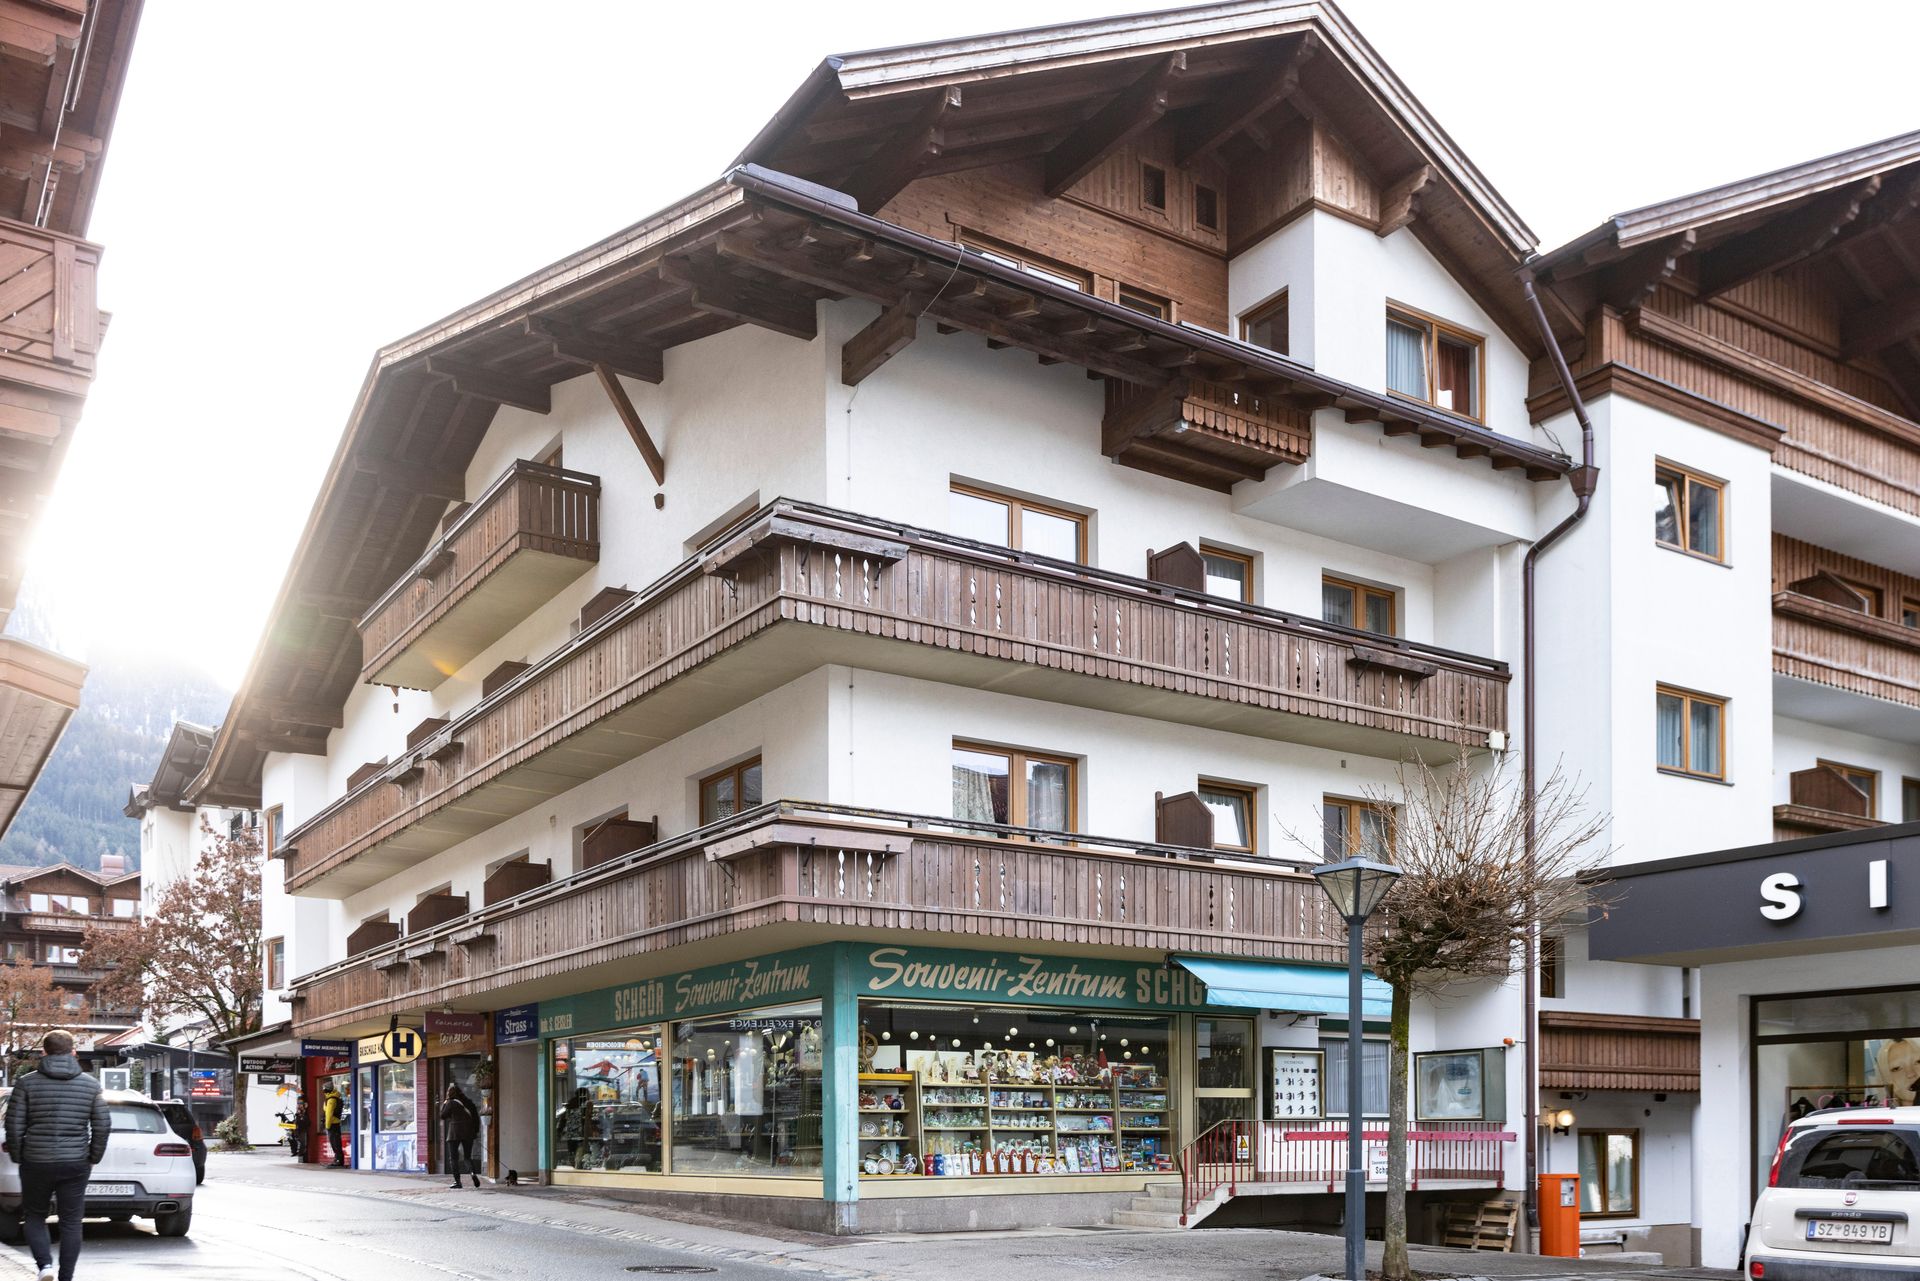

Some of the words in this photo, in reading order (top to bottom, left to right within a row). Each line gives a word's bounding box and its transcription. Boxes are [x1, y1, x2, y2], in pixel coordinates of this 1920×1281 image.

[869, 948, 1127, 998] Souvenir-Zentrum
[1136, 968, 1203, 1006] SCHG
[615, 980, 664, 1022] SCHGÖR
[675, 960, 810, 1013] Souvenir-Zentrum
[505, 1020, 527, 1035] Strass
[392, 1033, 414, 1057] H
[1818, 1223, 1834, 1236] SZ
[1843, 1224, 1867, 1238] 849
[1871, 1225, 1887, 1239] YB
